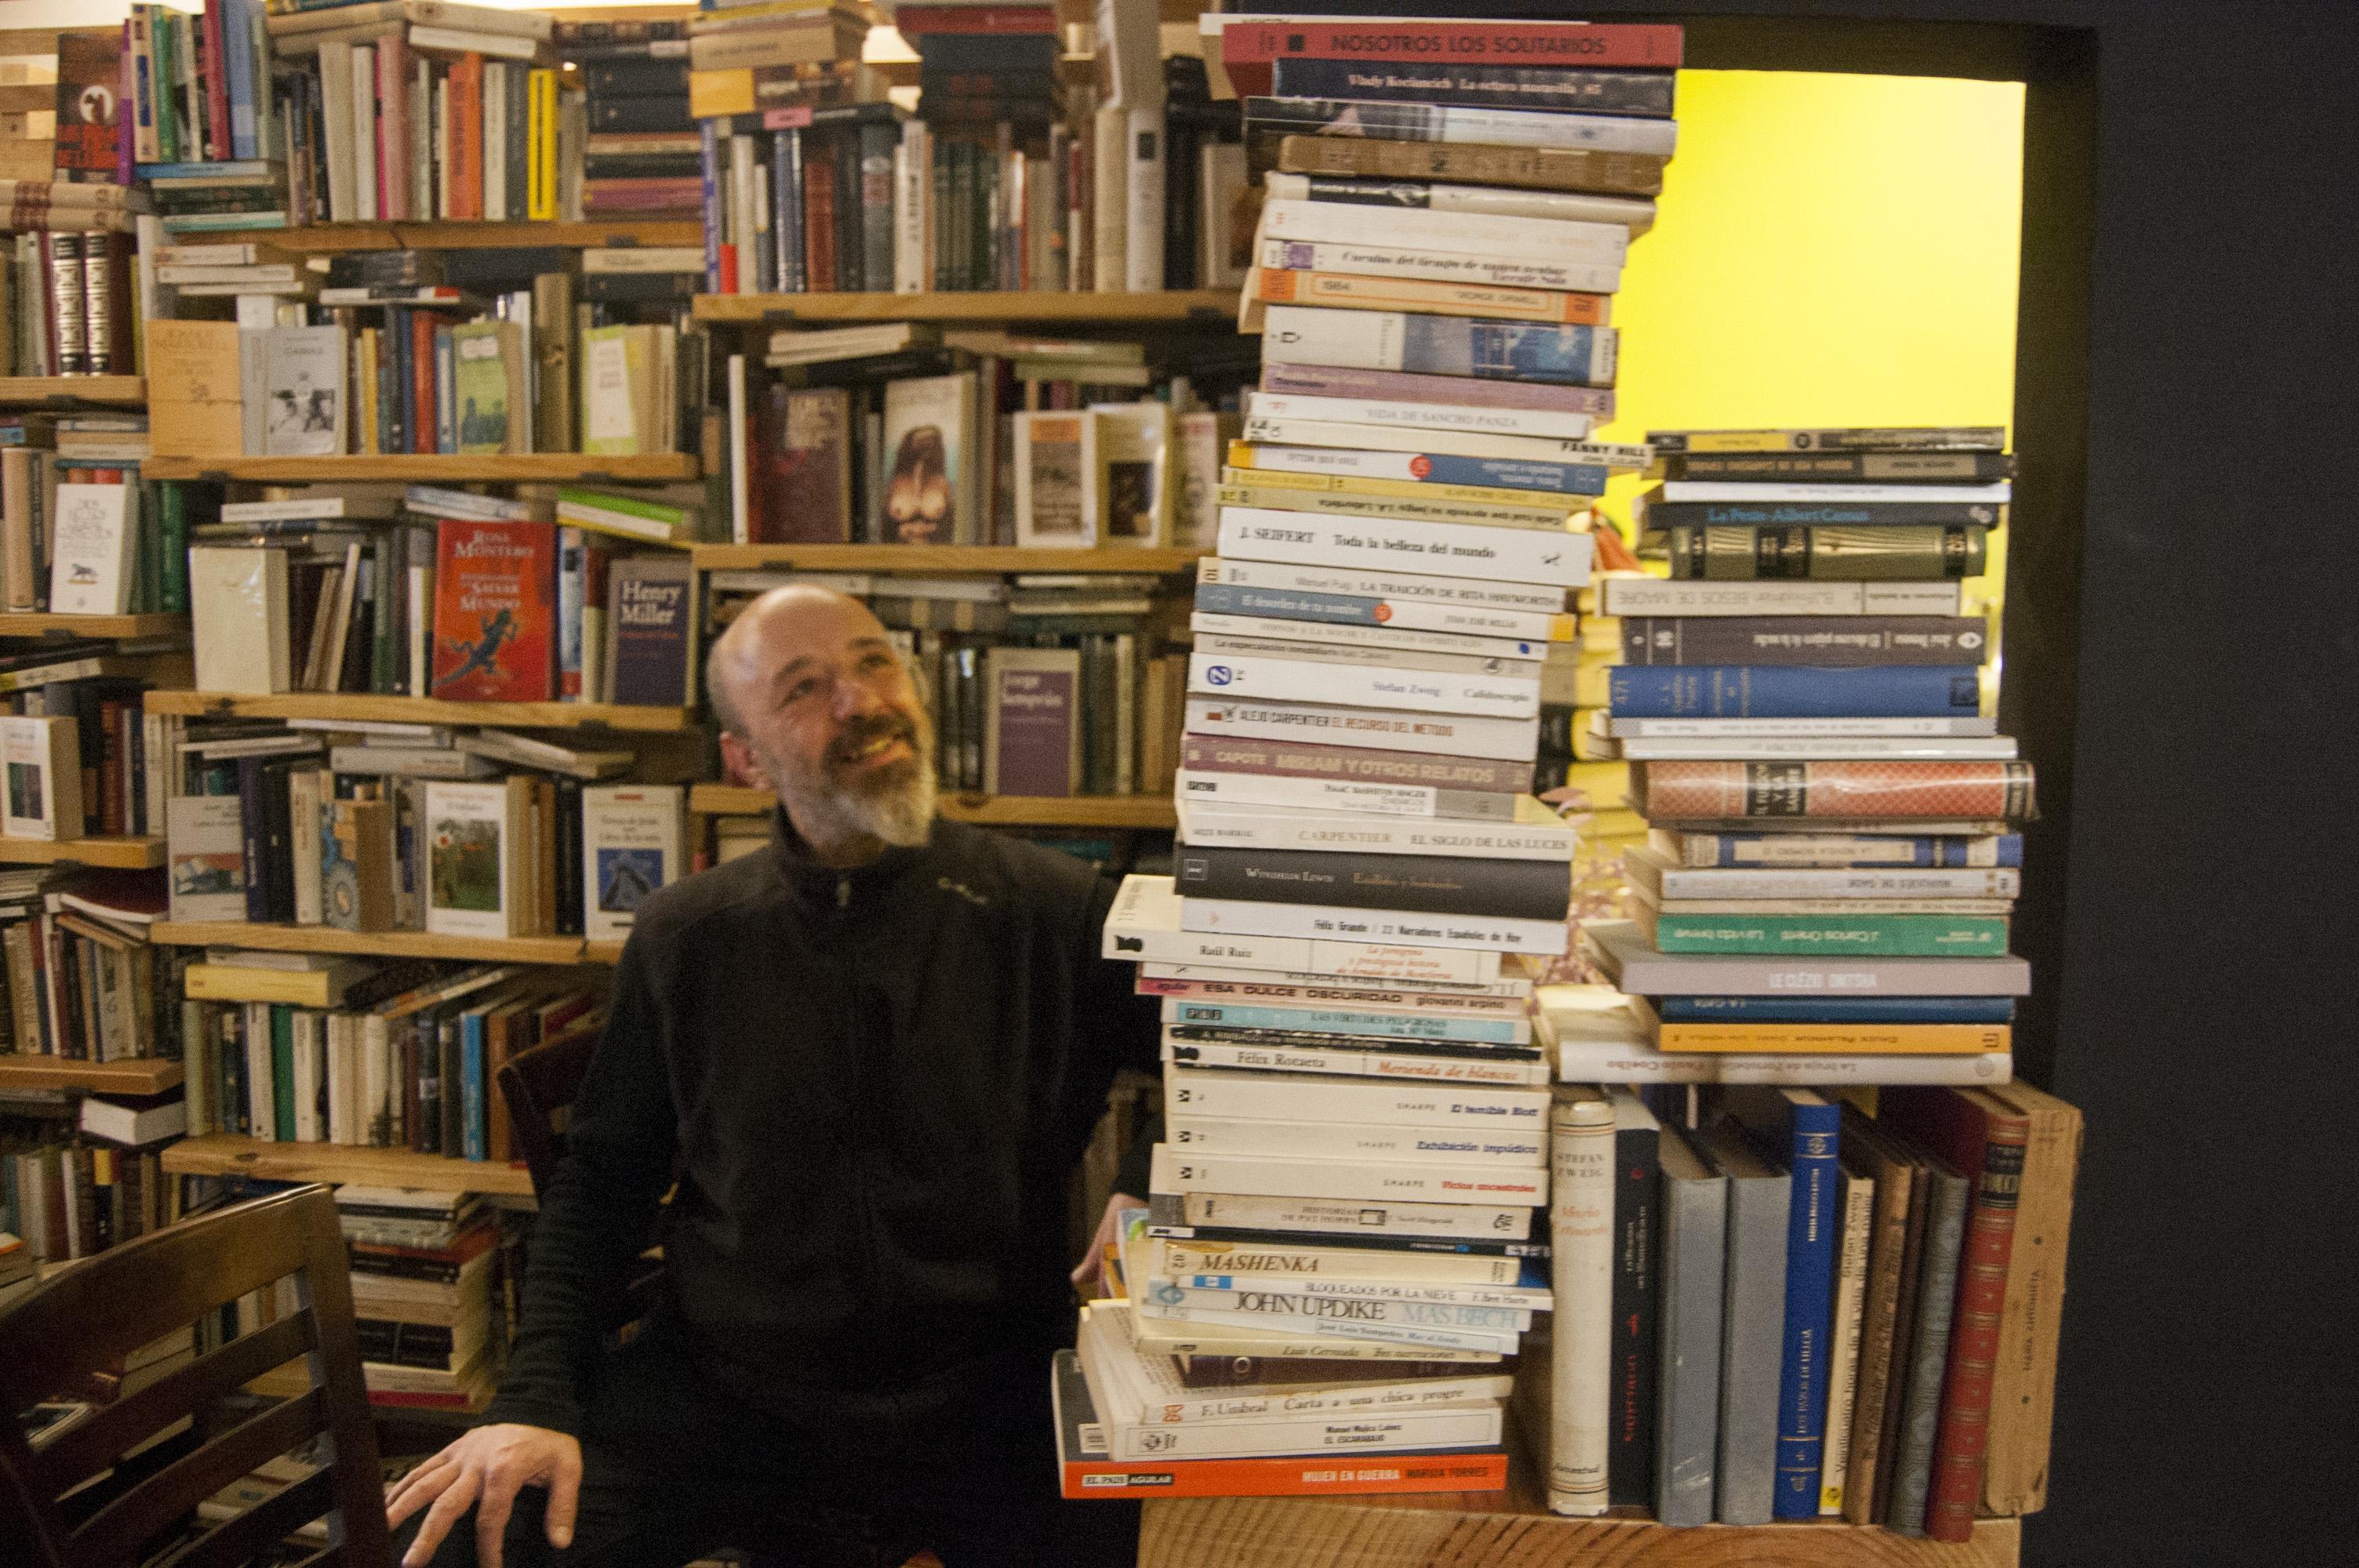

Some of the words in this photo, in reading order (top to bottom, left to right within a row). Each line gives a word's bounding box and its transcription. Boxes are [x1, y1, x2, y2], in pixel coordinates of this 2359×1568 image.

[1331, 34, 1441, 52] NOSOTROS
[1448, 38, 1485, 53] LOS
[1495, 38, 1608, 55] SOLITARIOS
[1400, 411, 1417, 421] DE
[1561, 441, 1610, 455] FANNY
[1617, 445, 1646, 457] HILL
[1238, 527, 1249, 539] J.
[1255, 528, 1316, 543] SEIFERT
[1332, 533, 1364, 547] Toda
[1367, 536, 1378, 549] la
[1383, 537, 1424, 554] belleza
[1429, 539, 1448, 555] del
[1452, 543, 1496, 559] mundo
[623, 580, 682, 607] Henry
[1360, 582, 1376, 593] LA
[1380, 583, 1434, 596] TRAICIÓN
[1438, 588, 1454, 598] DE
[1459, 589, 1487, 601] RITA
[1677, 590, 1696, 605] DE
[1700, 590, 1749, 605] BESOS
[1241, 595, 1255, 606] El
[620, 601, 675, 626] Miller
[1373, 680, 1407, 694] Stefan
[1409, 683, 1441, 698] Zweig
[1239, 709, 1268, 722] ALEJO
[1272, 712, 1329, 727] CARPENTIER
[1332, 717, 1343, 728] EL
[1347, 718, 1390, 732] RECURSO
[1393, 720, 1410, 733] DEL
[1216, 750, 1267, 765] CAPOTE
[1275, 753, 1343, 772] MIRIAM
[1344, 758, 1358, 772] Y
[1358, 759, 1417, 779] OTROS
[1419, 764, 1496, 783] RELATOS
[1299, 829, 1392, 844] CARPENTIER
[1411, 834, 1427, 845] EL
[1432, 834, 1472, 848] SIGLO
[1476, 837, 1492, 848] DE
[1496, 837, 1521, 849] LAS
[1525, 839, 1568, 851] LUCES
[1314, 919, 1334, 931] Félix
[1338, 920, 1369, 933] Grande
[1398, 924, 1442, 938] Narradores
[1447, 927, 1486, 941] Españoles
[1490, 931, 1501, 942] de
[1505, 931, 1522, 946] Hoy
[1200, 945, 1223, 956] Raúl
[1227, 946, 1253, 958] Ruiz
[1204, 983, 1235, 993] ESA
[1244, 985, 1297, 998] DULCE
[1307, 989, 1403, 1003] OSCURIDAD
[1416, 996, 1464, 1008] giovanni
[1467, 999, 1507, 1011] arpino
[1236, 1051, 1270, 1065] Félix
[1379, 1061, 1441, 1077] Merienda
[1445, 1062, 1463, 1076] de
[1605, 1060, 1660, 1074] Coelho
[1785, 1062, 1802, 1073] de
[1805, 1061, 1837, 1074] bruja
[1839, 1062, 1857, 1073] La
[1397, 1102, 1438, 1112] SHARPE
[1451, 1104, 1465, 1113] El
[1357, 1141, 1397, 1150] SHARPE
[1383, 1178, 1426, 1189] SHARPE
[1845, 1192, 1863, 1232] Zweig
[1200, 1254, 1321, 1273] MASHENKA
[1841, 1236, 1856, 1279] Stefan
[1306, 1282, 1377, 1296] BLOQUEADOS
[1379, 1286, 1400, 1298] POR
[1404, 1287, 1420, 1298] LA
[1423, 1289, 1457, 1301] NIEVE
[1235, 1290, 1299, 1314] JOHN
[1301, 1296, 1388, 1321] UPDIKE
[1456, 1306, 1520, 1329] BECH
[1282, 1344, 1308, 1356] Luis
[1310, 1345, 1361, 1357] Cernuda
[1373, 1346, 1393, 1358] Tres
[1394, 1348, 1456, 1360] narraciones
[1284, 1396, 1324, 1412] Carta
[1331, 1399, 1340, 1408] a
[1349, 1396, 1374, 1406] una
[1381, 1391, 1416, 1404] chica
[1422, 1388, 1465, 1403] progre
[1201, 1405, 1216, 1417] F.
[1217, 1400, 1269, 1416] Umbral
[1325, 1425, 1351, 1434] Manuel
[1324, 1436, 1335, 1445] EL
[1085, 1476, 1100, 1486] EL
[1127, 1474, 1173, 1484] AGUILAR
[1302, 1468, 1339, 1483] MUJER
[1339, 1469, 1356, 1482] EN
[1357, 1468, 1401, 1481] GUERRA
